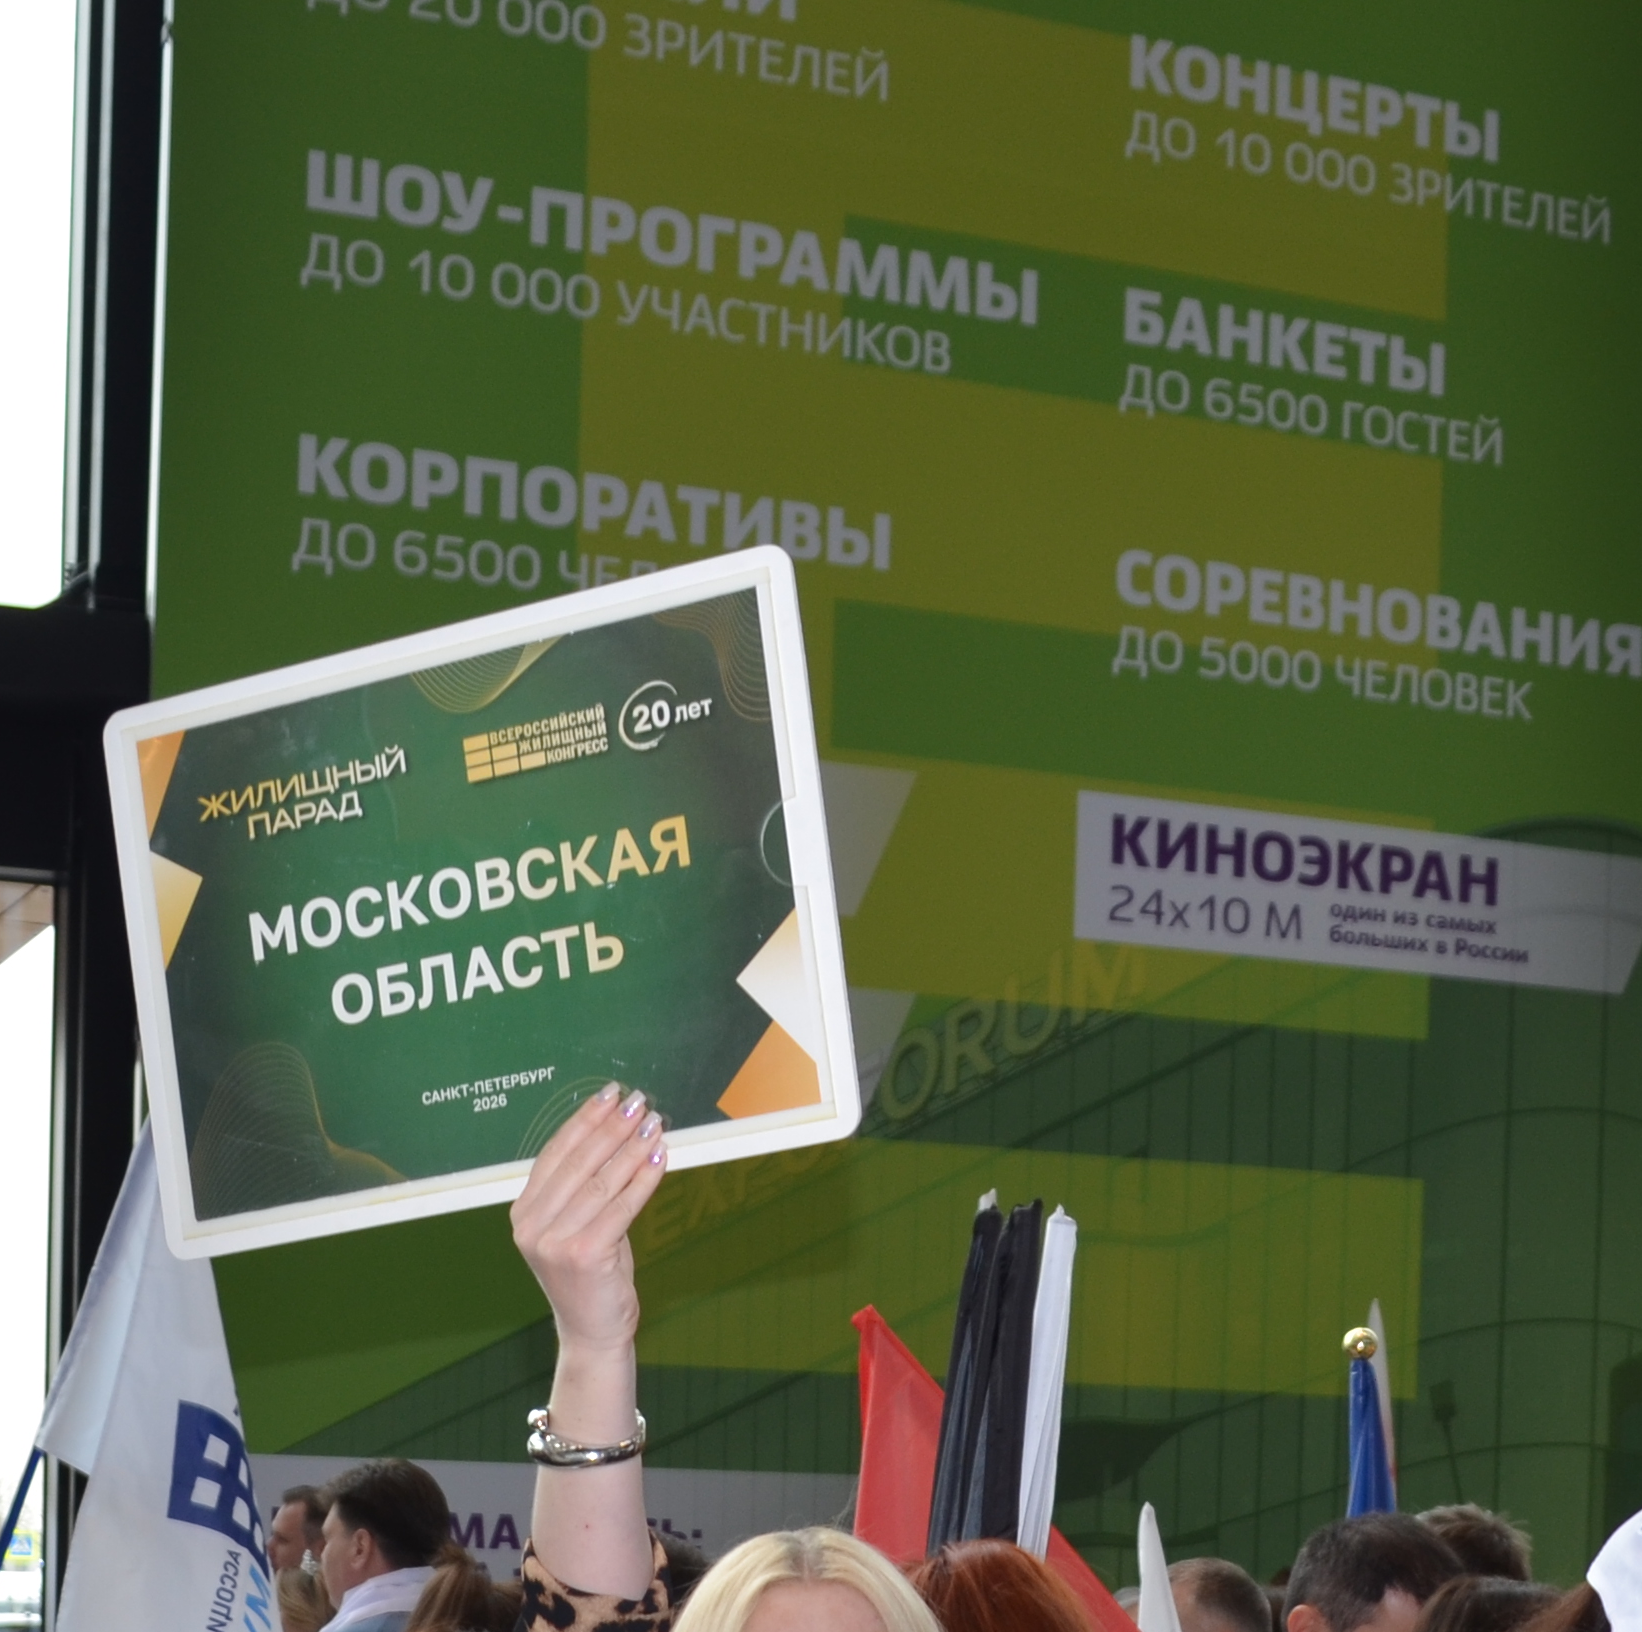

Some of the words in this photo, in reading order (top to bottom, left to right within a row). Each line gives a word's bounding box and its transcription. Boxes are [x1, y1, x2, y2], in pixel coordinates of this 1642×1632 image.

[623, 13, 889, 101] ЗРИТЕЛЕЙ
[1130, 34, 1500, 162] КОНЦЕРТЫ
[1126, 110, 1196, 162] ДО
[1216, 129, 1271, 176] 10
[1284, 141, 1376, 195] 000
[1389, 162, 1612, 245] ЗРИТЕЛЕЙ
[306, 149, 1039, 327] ШОУ-ПРОГРАММЫ
[301, 233, 384, 291] ДО
[408, 252, 475, 299] 10
[491, 262, 601, 318] 000
[616, 281, 950, 375] УЧАСТНИКОВ
[1124, 287, 1445, 397] БАНКЕТЫ
[1119, 364, 1189, 417] ДО
[1204, 378, 1327, 434] 6500
[1342, 402, 1503, 466] ГОСТЕЙ
[297, 433, 892, 572] КОРПОРАТИВЫ
[292, 517, 376, 574] ДО
[394, 531, 542, 589] 6500
[1116, 548, 1642, 679] СОРЕВНОВАНИЯ
[632, 700, 671, 734] 20
[675, 698, 712, 723] лет
[1112, 626, 1183, 679] ДО
[1200, 636, 1323, 693] 5000
[1335, 655, 1532, 721] ЧЕЛОВЕК
[490, 703, 605, 746] ВСЕРОССИЙСКИЙ
[519, 721, 607, 754] ЖИЛИЩНЫЙ
[547, 738, 608, 764] КОНГРЕСС
[198, 744, 407, 822] ЖИЛИЩНЫЙ
[248, 790, 363, 840] ПАРАД
[248, 815, 691, 965] МОСКОВСКАЯ
[1111, 813, 1498, 906] КИНОЭКРАН
[1329, 924, 1428, 954] больших
[1453, 938, 1529, 964] России
[1330, 903, 1386, 924] один
[1393, 909, 1417, 925] из
[1426, 913, 1497, 935] самых
[330, 921, 625, 1026] ОБЛАСТЬ
[422, 1066, 555, 1105] САНКТ-ПЕТЕРБУРГ
[473, 1093, 507, 1112] 2026
